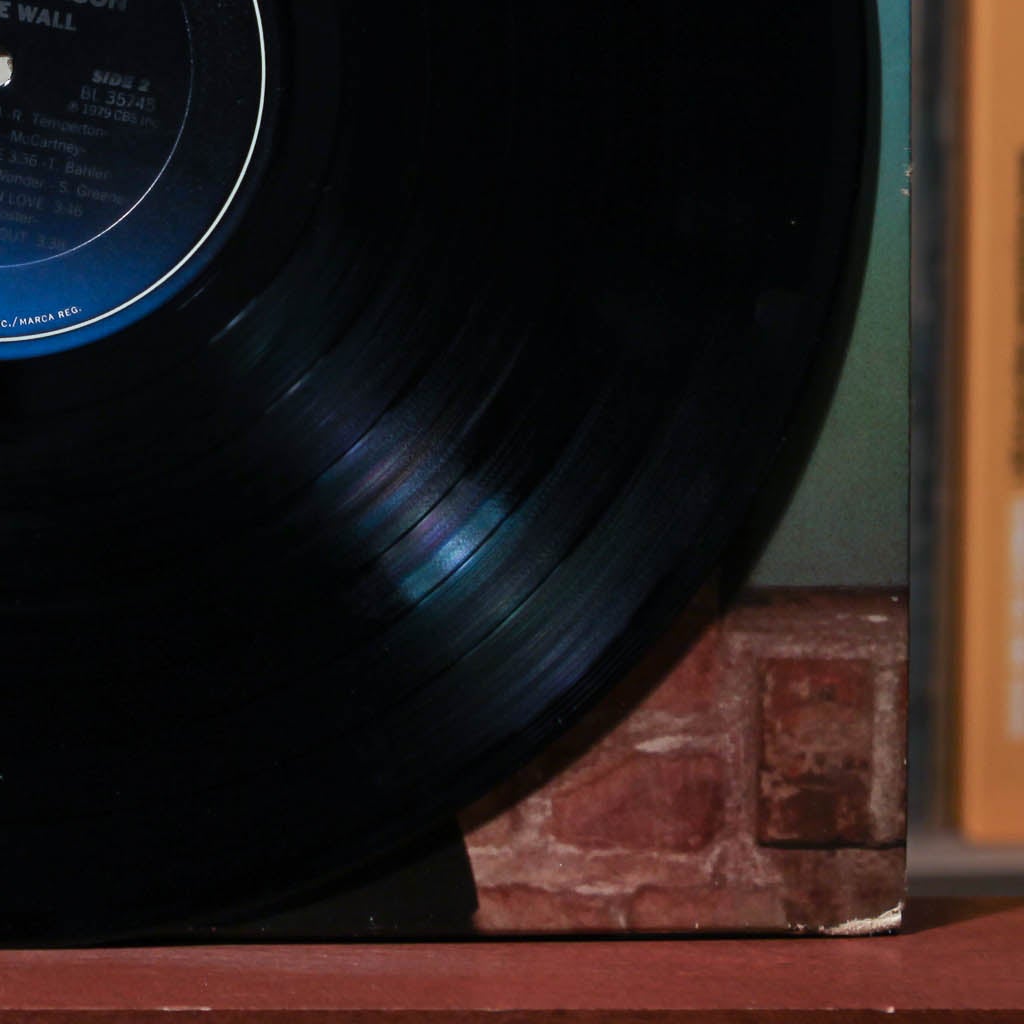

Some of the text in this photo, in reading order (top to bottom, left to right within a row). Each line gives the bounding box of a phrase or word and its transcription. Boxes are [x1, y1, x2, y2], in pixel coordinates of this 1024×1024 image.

[15, 2, 78, 33] WALL
[90, 68, 135, 90] SIDE
[103, 88, 157, 113] 35745
[57, 305, 83, 319] REG.
